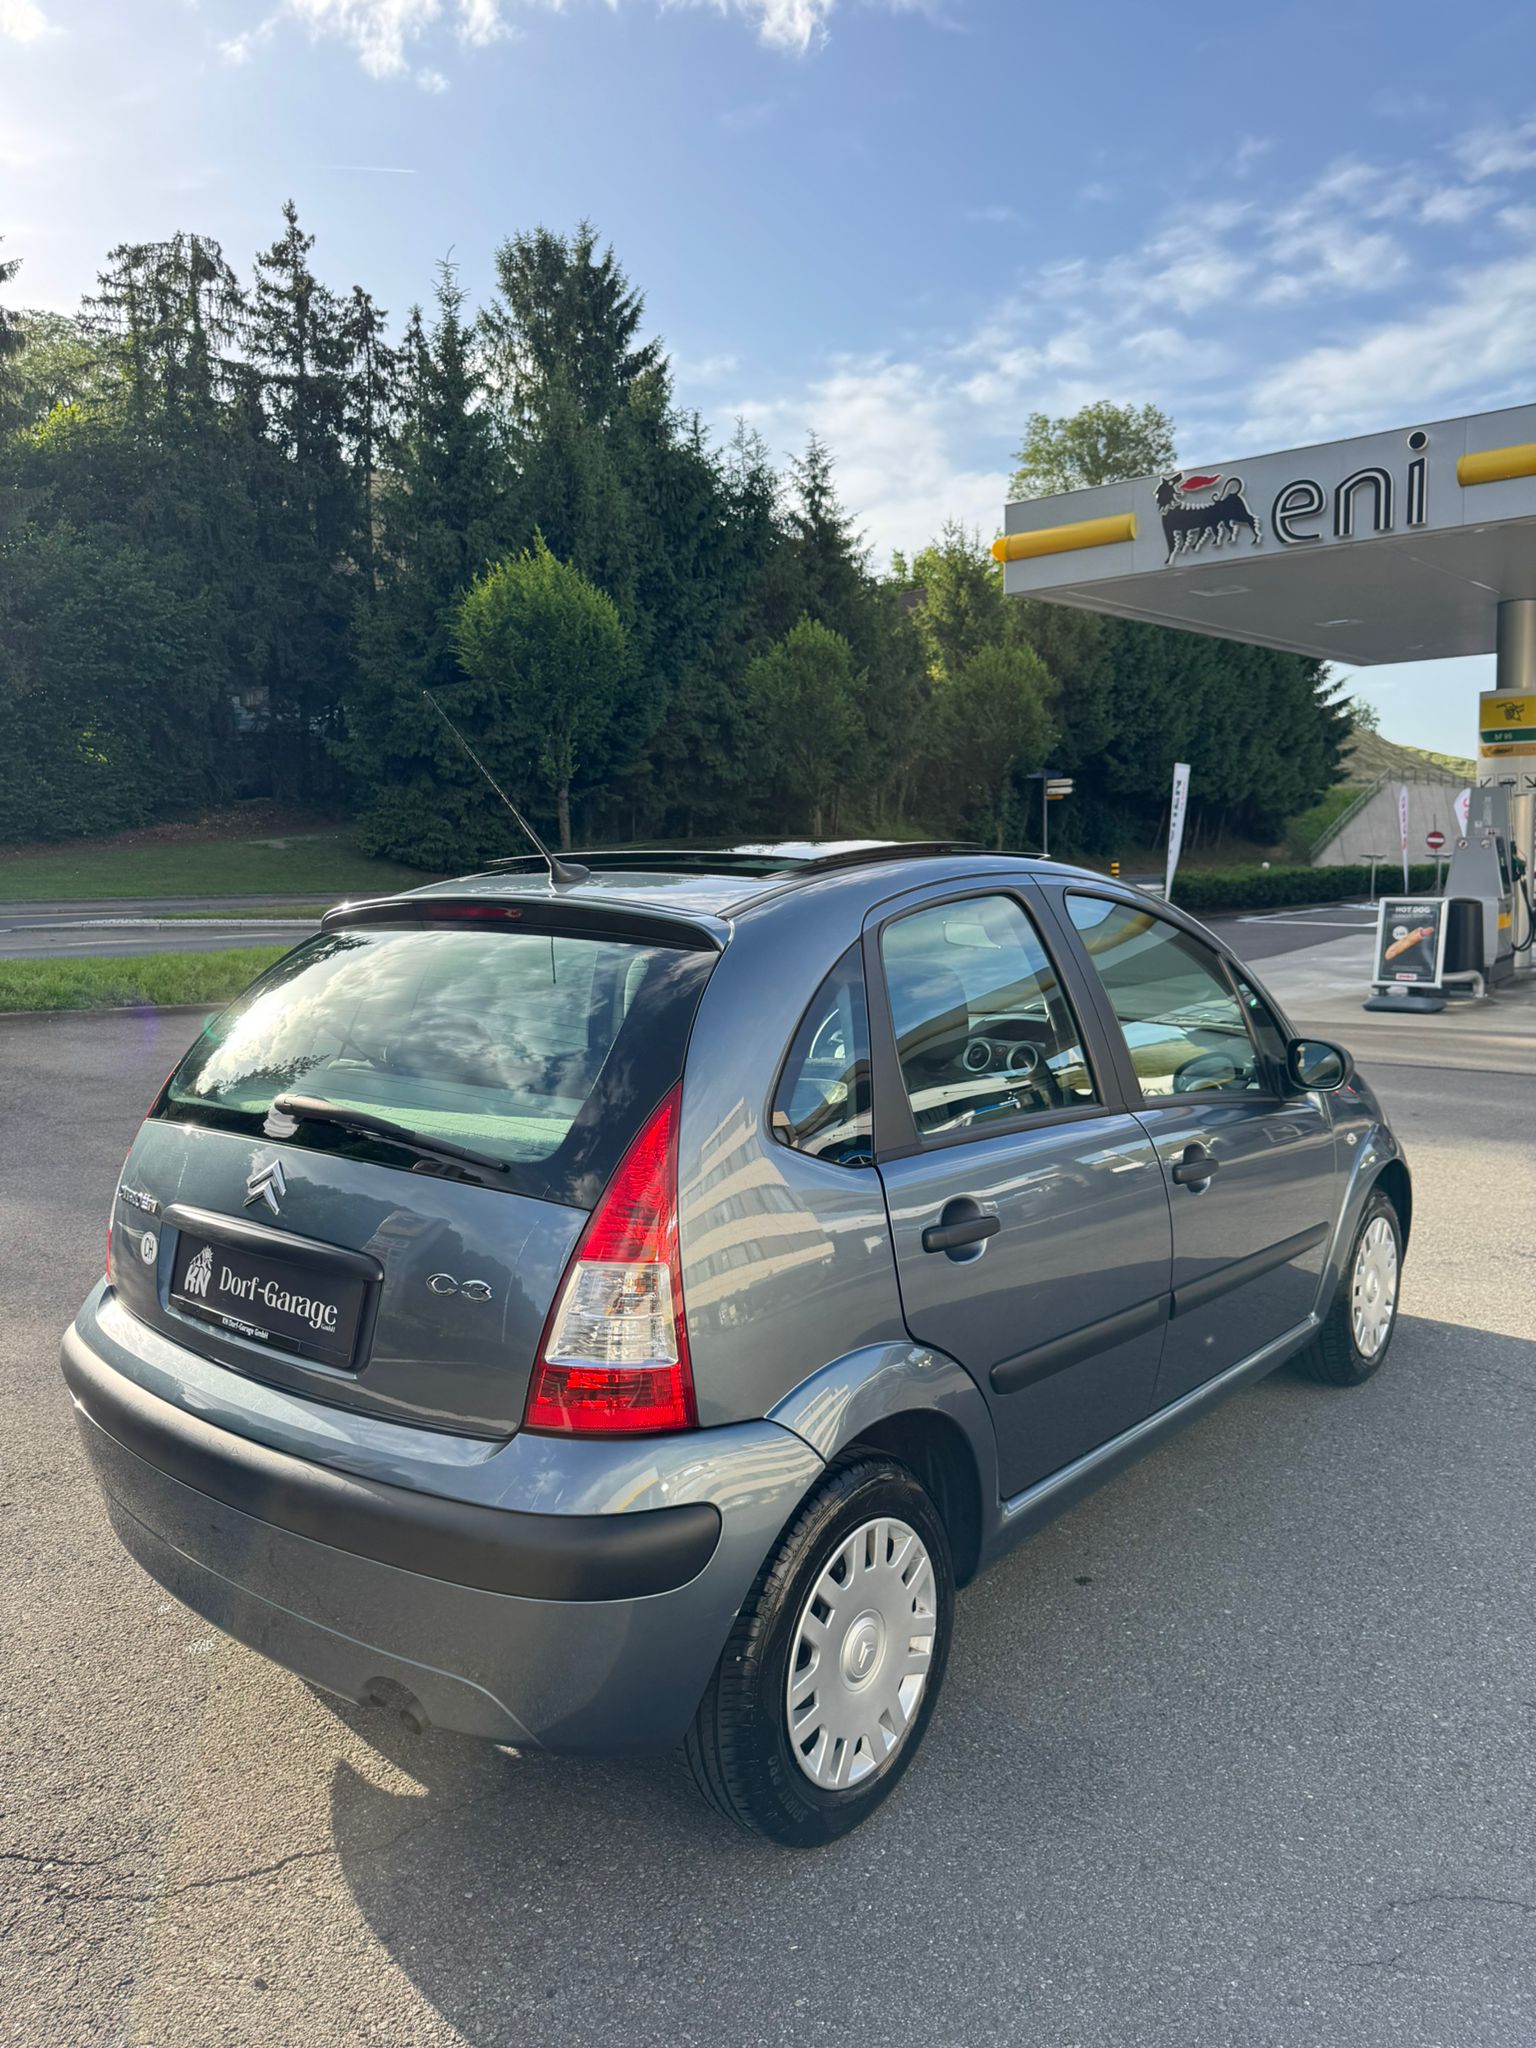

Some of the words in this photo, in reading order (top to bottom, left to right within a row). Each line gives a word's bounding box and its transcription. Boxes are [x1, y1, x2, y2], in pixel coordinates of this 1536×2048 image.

[1271, 430, 1428, 543] eni
[144, 1237, 154, 1259] CH
[184, 1264, 211, 1298] KN
[426, 1273, 492, 1304] C3
[219, 1266, 338, 1329] Dorf-Garage
[229, 1319, 254, 1336] Dorf-Garage
[254, 1328, 269, 1339] GmbH
[321, 1323, 336, 1333] GmbH
[767, 1755, 781, 1786] PRO
